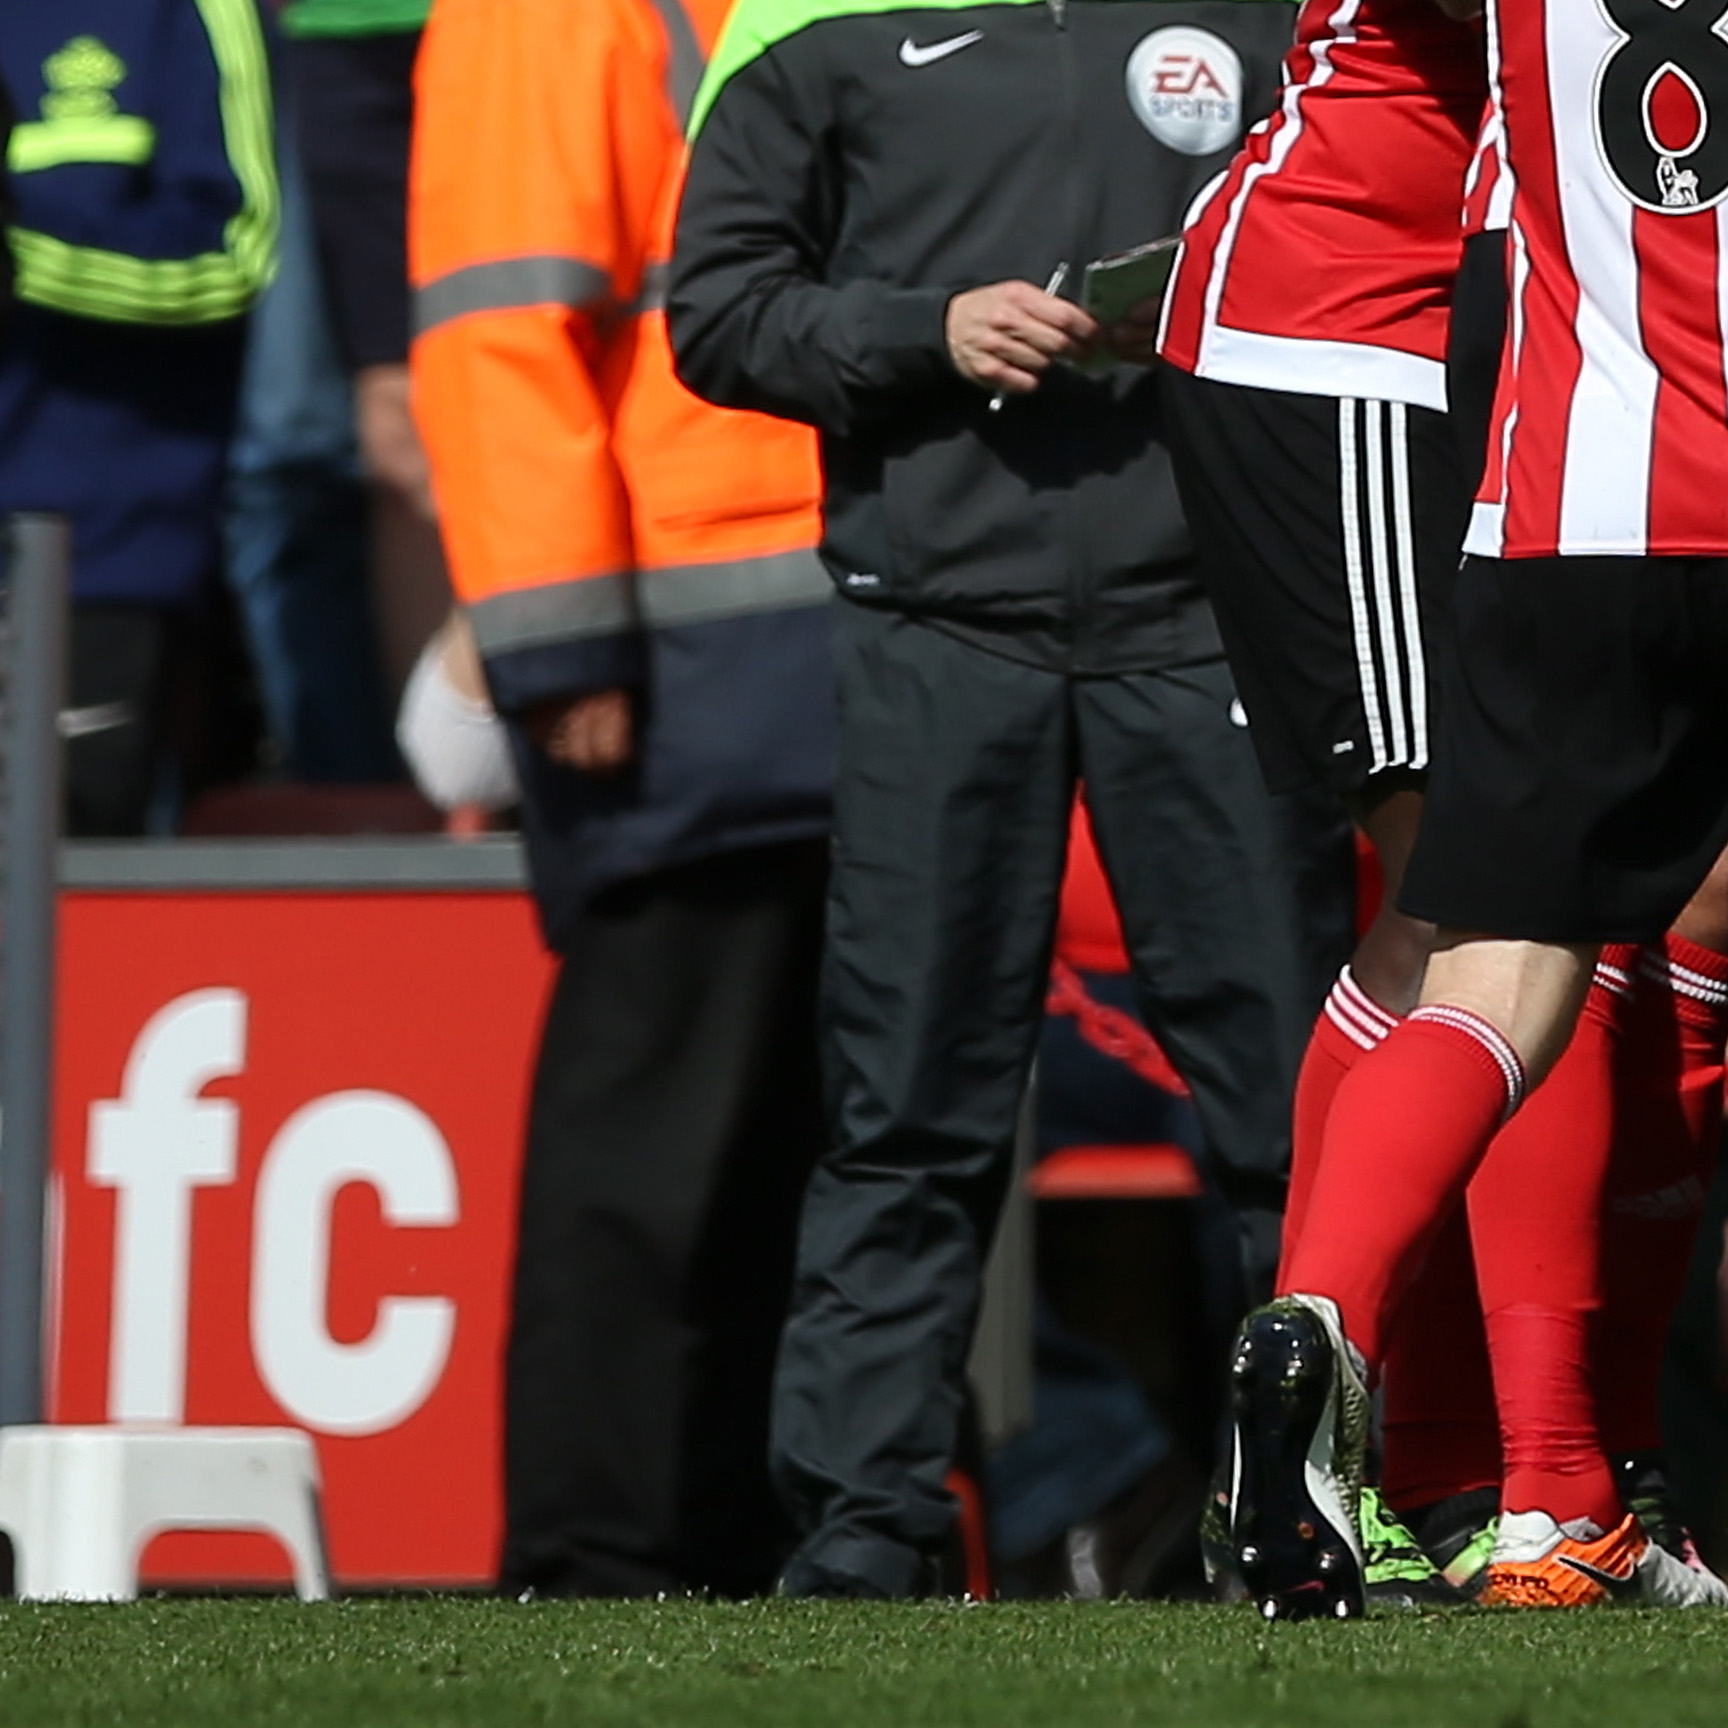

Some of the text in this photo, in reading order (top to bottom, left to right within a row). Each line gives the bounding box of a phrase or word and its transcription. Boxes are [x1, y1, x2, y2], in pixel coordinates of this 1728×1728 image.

[1154, 55, 1229, 98] EA
[1149, 96, 1234, 122] SPORTS
[86, 988, 459, 1436] fc
